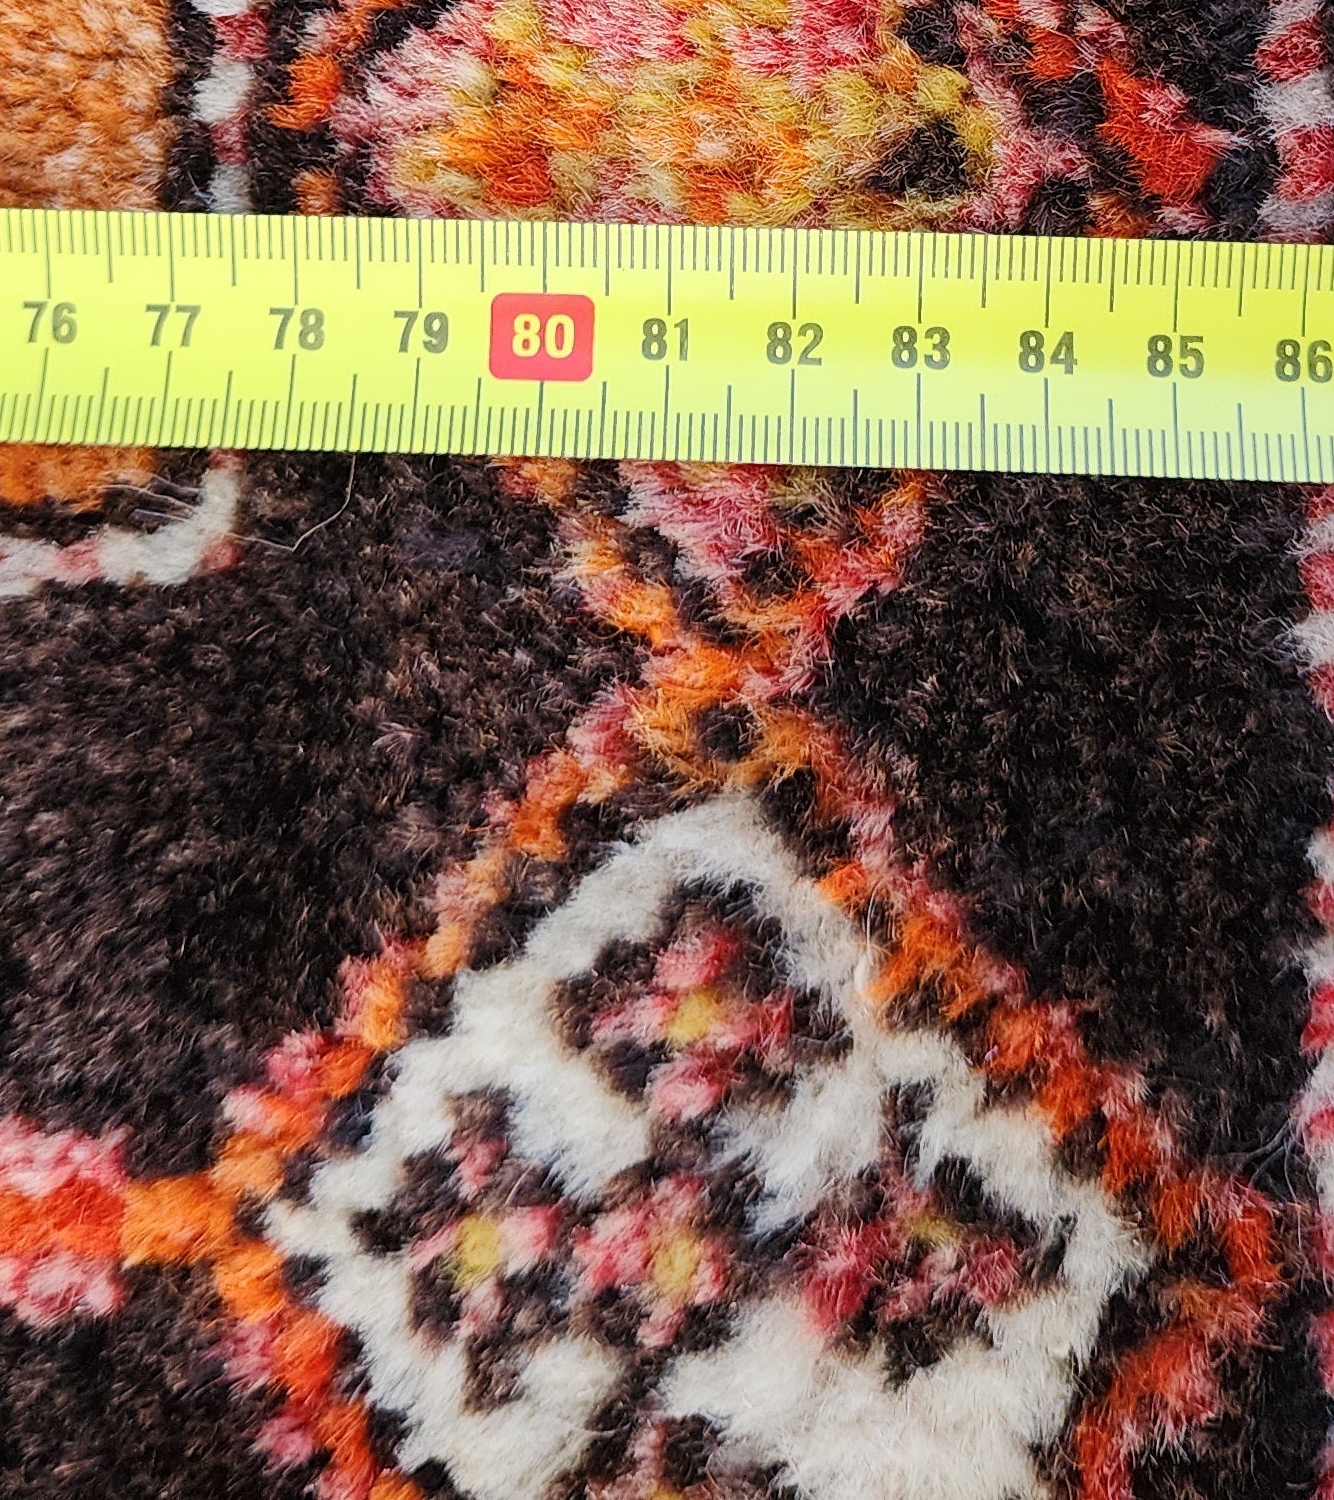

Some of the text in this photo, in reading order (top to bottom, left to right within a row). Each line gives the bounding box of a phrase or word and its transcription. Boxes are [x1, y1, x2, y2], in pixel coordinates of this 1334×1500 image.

[23, 301, 78, 344] 76
[145, 304, 201, 348] 77
[269, 308, 325, 351] 78
[393, 311, 449, 354] 79
[512, 314, 575, 359] 80
[641, 318, 691, 361] 81
[766, 322, 824, 366] 82
[891, 325, 951, 369] 83
[1018, 331, 1078, 375] 84
[1146, 335, 1205, 379] 85
[1275, 339, 1334, 383] 86
